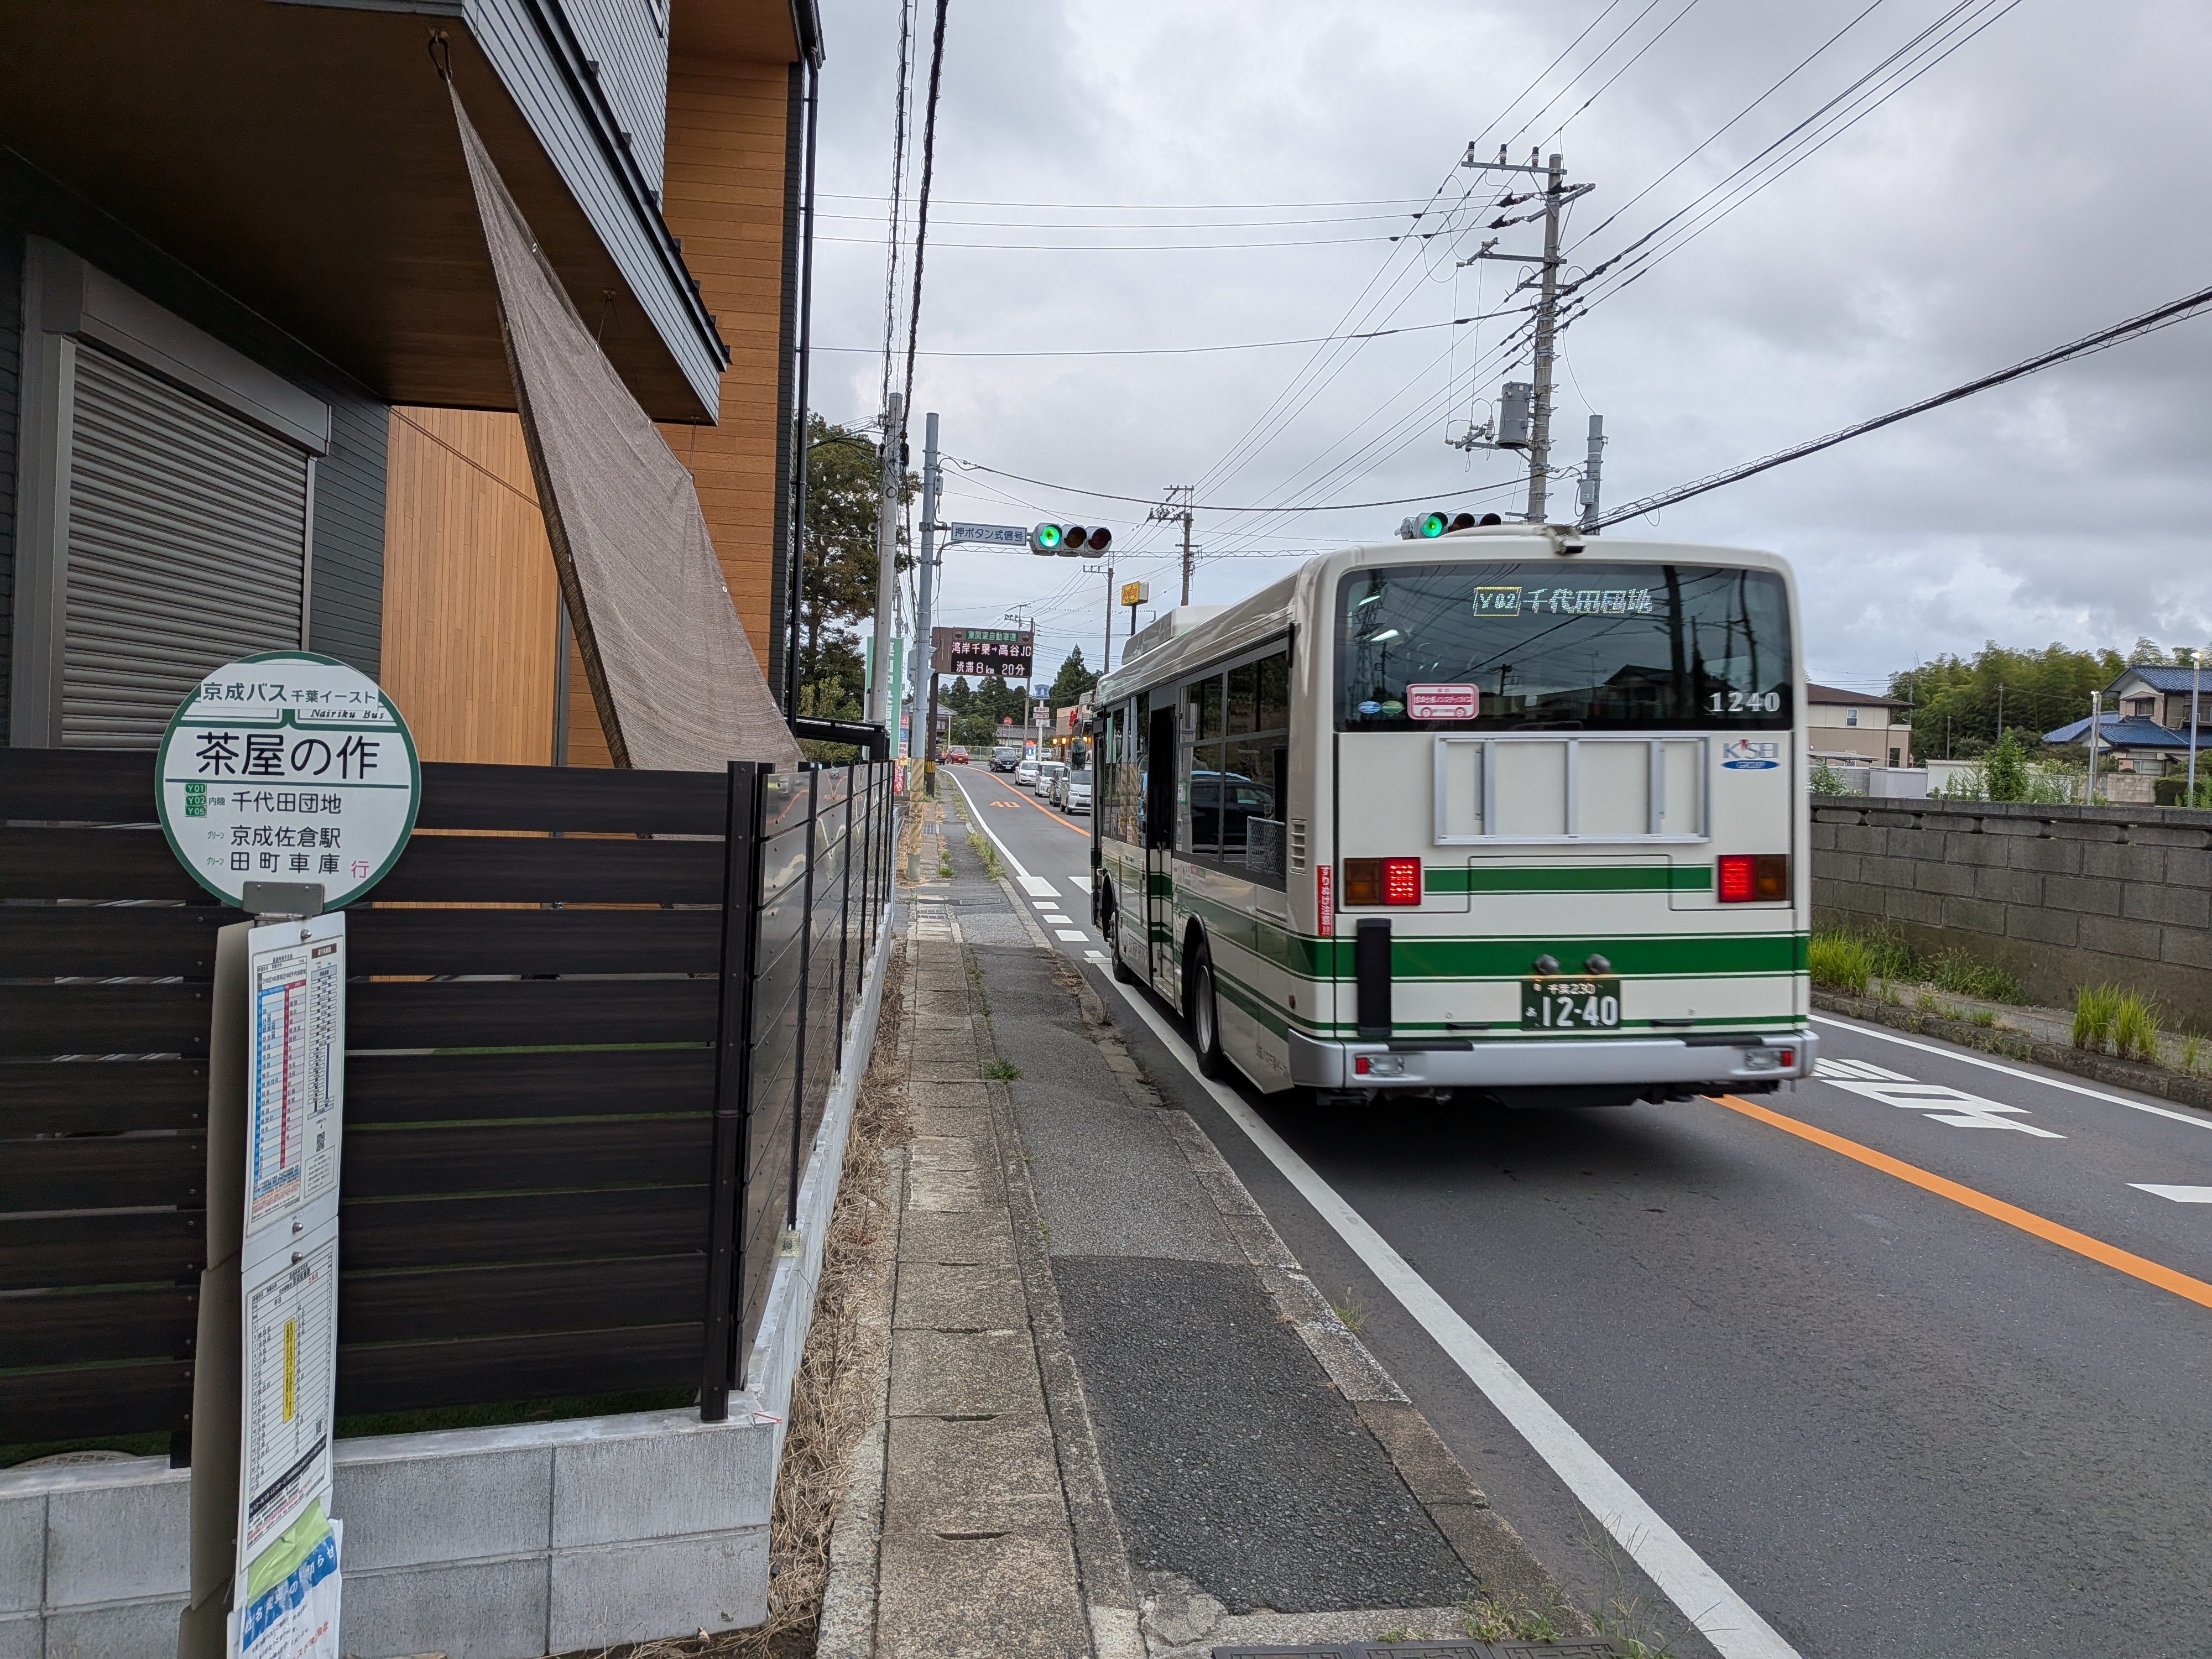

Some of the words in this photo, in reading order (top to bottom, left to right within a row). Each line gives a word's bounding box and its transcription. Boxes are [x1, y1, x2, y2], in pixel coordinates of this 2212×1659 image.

[954, 526, 1024, 542] 押ボタン式信号
[1479, 593, 1517, 609] Y02
[1523, 588, 1652, 613] 千代田団地
[968, 630, 1016, 641] 東関東自動車道
[951, 641, 990, 655] 湾岸千葉
[998, 644, 1031, 656] 高谷JC
[1001, 664, 1025, 675] 20分
[203, 682, 288, 702] 京成バス
[291, 690, 376, 704] 千葉イースト
[1709, 692, 1780, 712] 1240
[310, 709, 356, 718] Nairiku
[363, 711, 384, 719] Bus
[196, 731, 380, 779] 茶屋の作
[208, 797, 225, 806] 内陸
[231, 791, 341, 815] 千代田団地
[231, 825, 341, 848] 京成佐倉駅
[207, 857, 224, 865] グリーン
[231, 852, 340, 874] 田町車庫
[351, 860, 369, 879] 行
[1542, 996, 1618, 1027] 12-40
